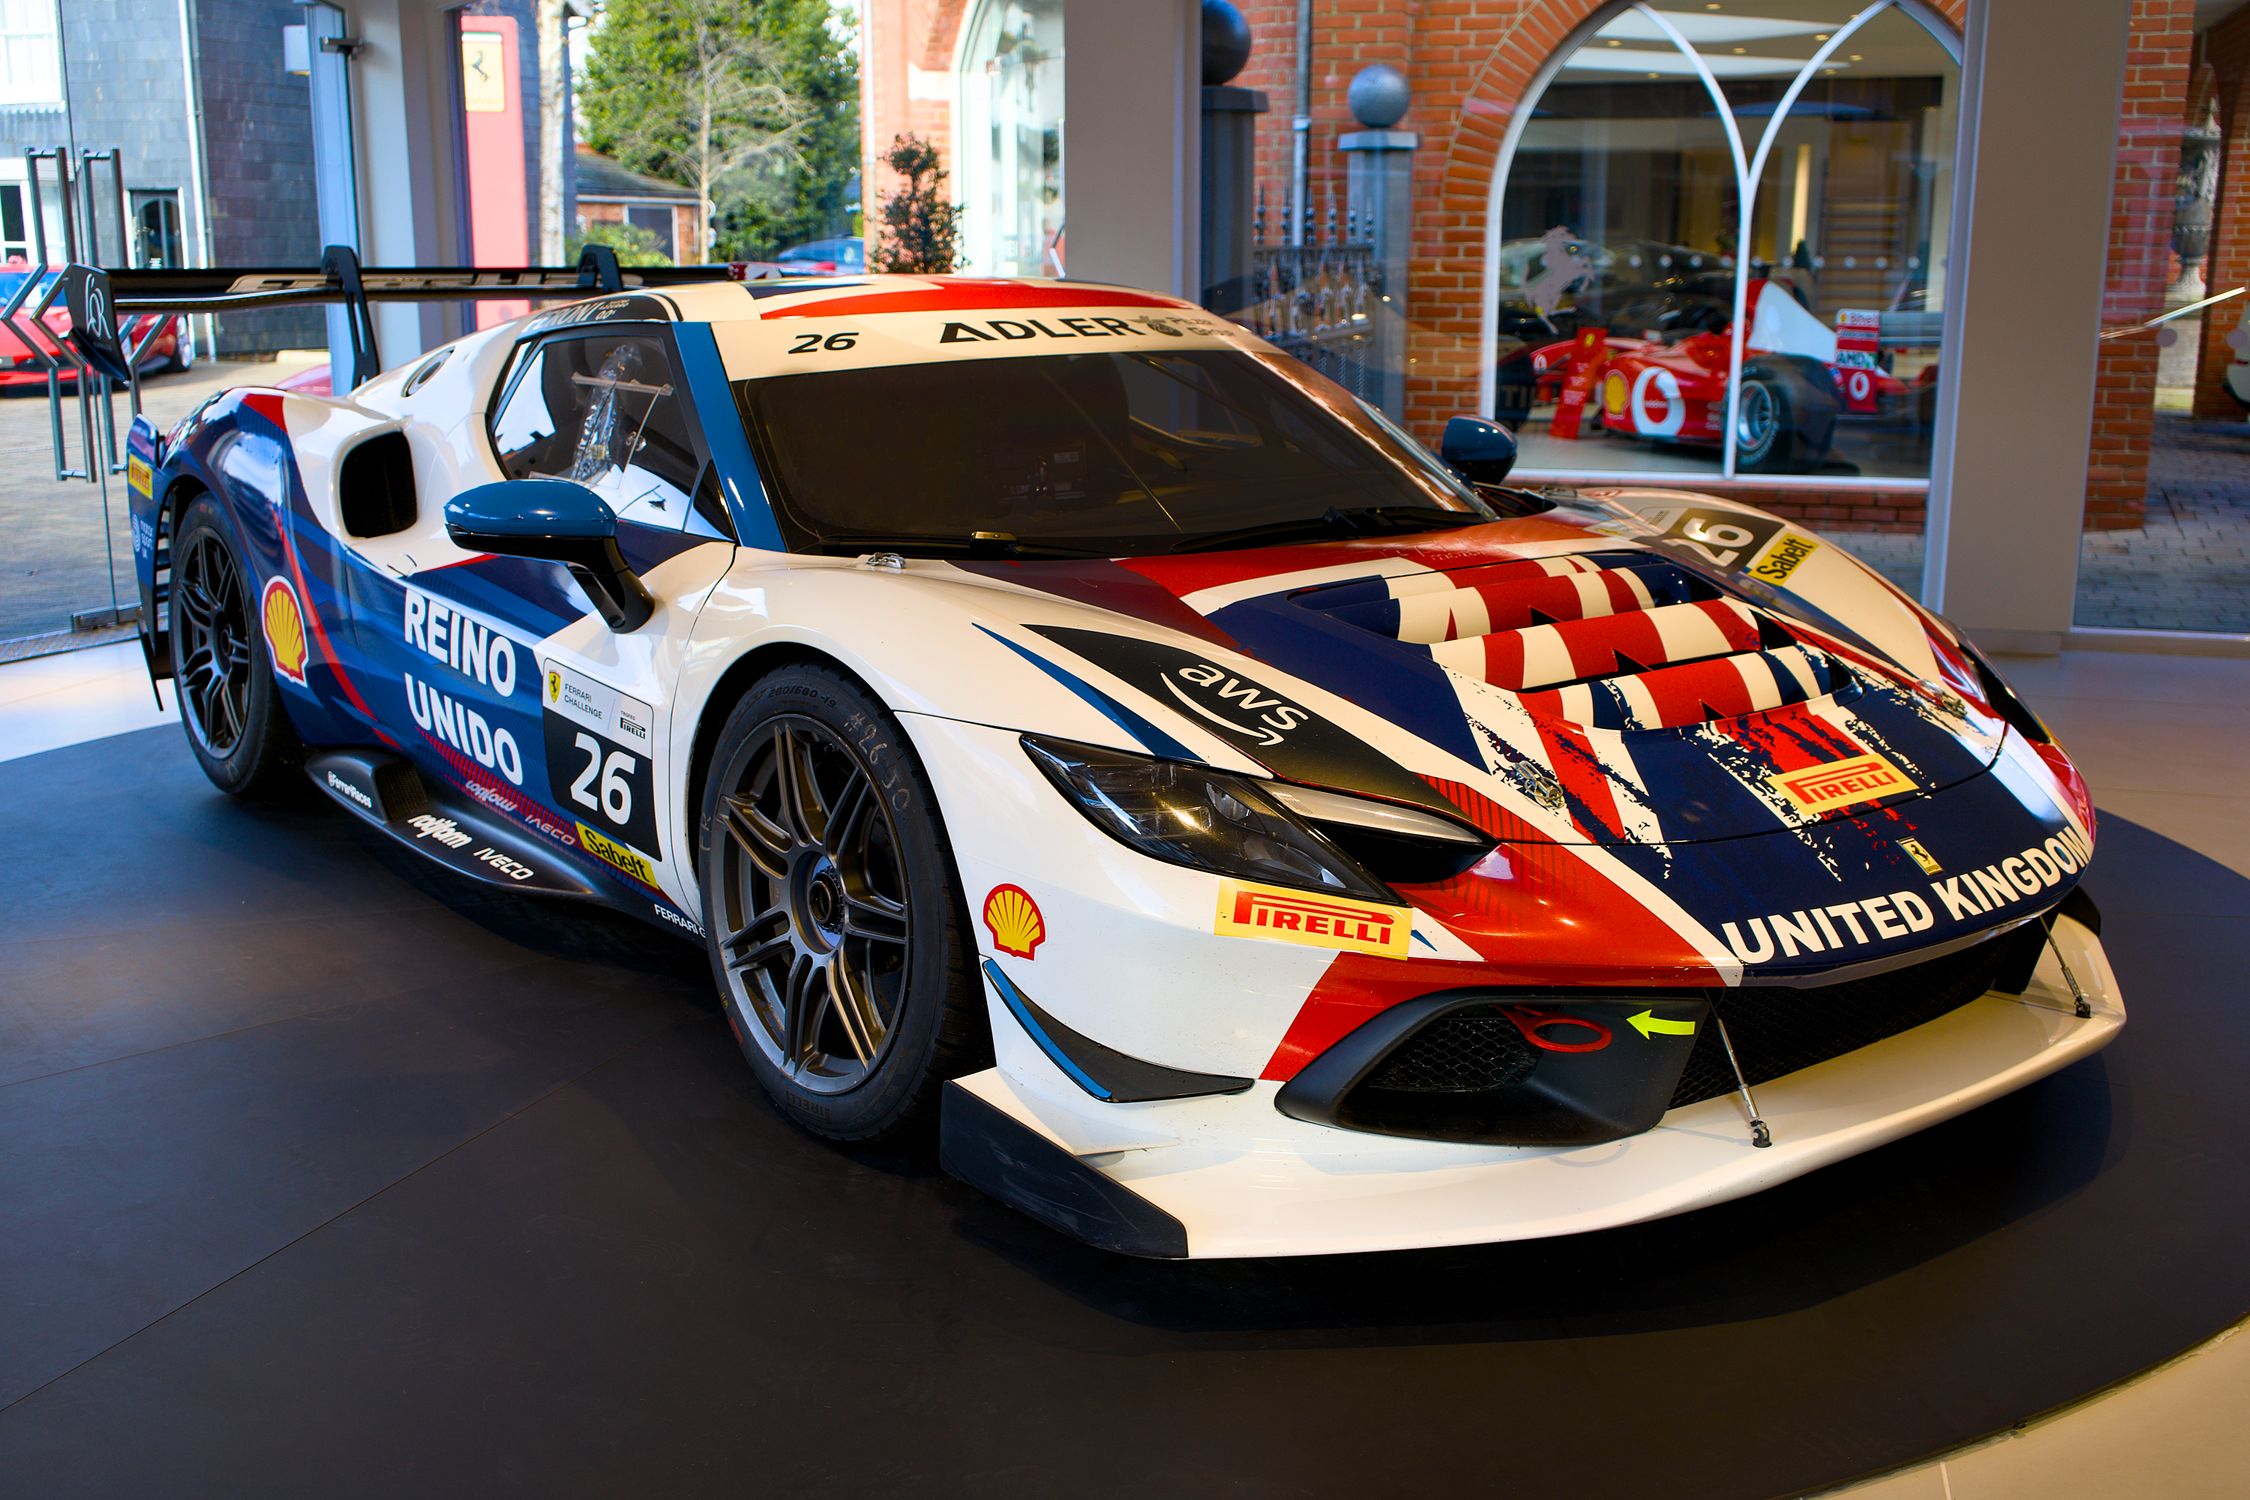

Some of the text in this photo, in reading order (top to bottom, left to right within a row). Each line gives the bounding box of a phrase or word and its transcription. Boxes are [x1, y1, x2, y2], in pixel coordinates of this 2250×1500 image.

[788, 316, 1146, 355] 26 ADLER
[131, 462, 150, 490] PIRELLI
[1661, 516, 1755, 568] 26
[1756, 537, 1814, 580] Sabelt
[404, 588, 516, 697] REINO
[564, 683, 592, 702] FERRARI
[564, 694, 603, 720] CHALLENGE
[1177, 662, 1309, 732] aws
[404, 672, 523, 786] UNIDO
[619, 716, 646, 740] PIRELLI
[570, 731, 637, 825] 26
[1782, 761, 1899, 805] PIRELLI
[472, 847, 534, 881] IVECO
[585, 829, 650, 884] Sabelt
[1720, 825, 2094, 965] UNITED KINGDOM
[653, 903, 699, 936] FERRARI
[1232, 889, 1396, 946] PIRELLI
